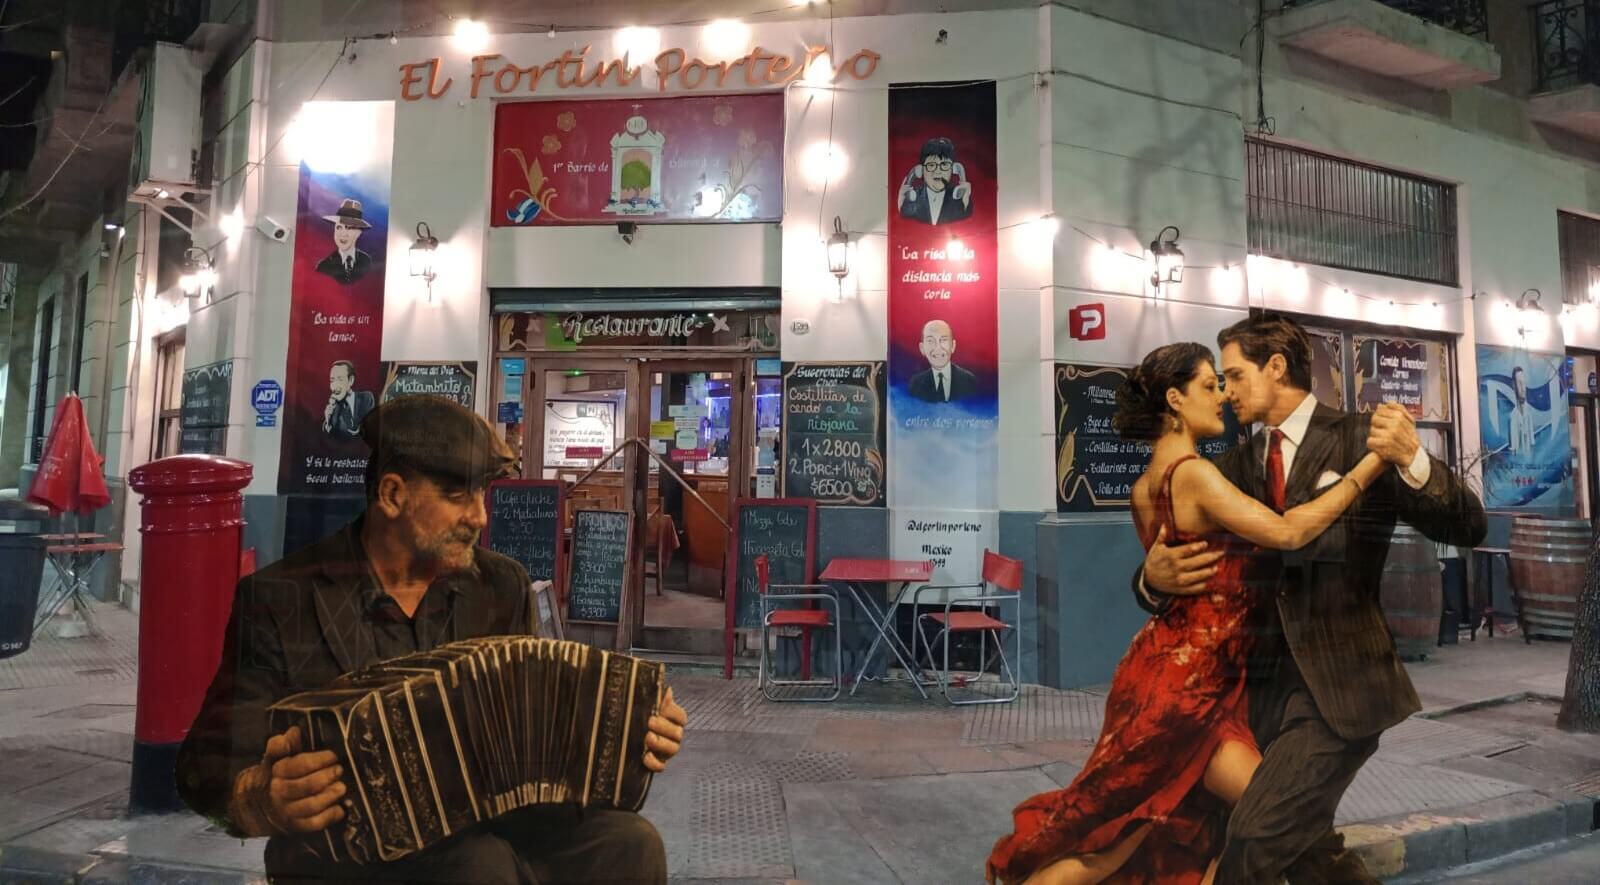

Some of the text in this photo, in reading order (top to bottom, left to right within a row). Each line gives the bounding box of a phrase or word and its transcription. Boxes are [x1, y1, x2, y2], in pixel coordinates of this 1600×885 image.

[399, 57, 454, 101] El
[469, 45, 648, 98] Fortín
[567, 161, 595, 173] Barrio
[597, 160, 609, 172] de
[923, 248, 946, 260] risa
[902, 270, 952, 283] distancia
[923, 288, 952, 300] corta
[329, 313, 347, 325] vida
[347, 315, 356, 325] es
[357, 315, 370, 325] un
[852, 366, 867, 378] del
[395, 377, 462, 394] Matambrito
[256, 389, 280, 403] ADT
[789, 386, 867, 403] Costillitas de
[789, 401, 862, 415] cerdo a la
[1089, 441, 1119, 454] Costillas
[1126, 442, 1134, 454] la
[306, 456, 313, 468] Y
[789, 458, 802, 475] 2
[1090, 462, 1127, 474] Tallarines
[1128, 464, 1140, 474] con
[810, 477, 853, 497] $6500
[1114, 483, 1121, 495] al
